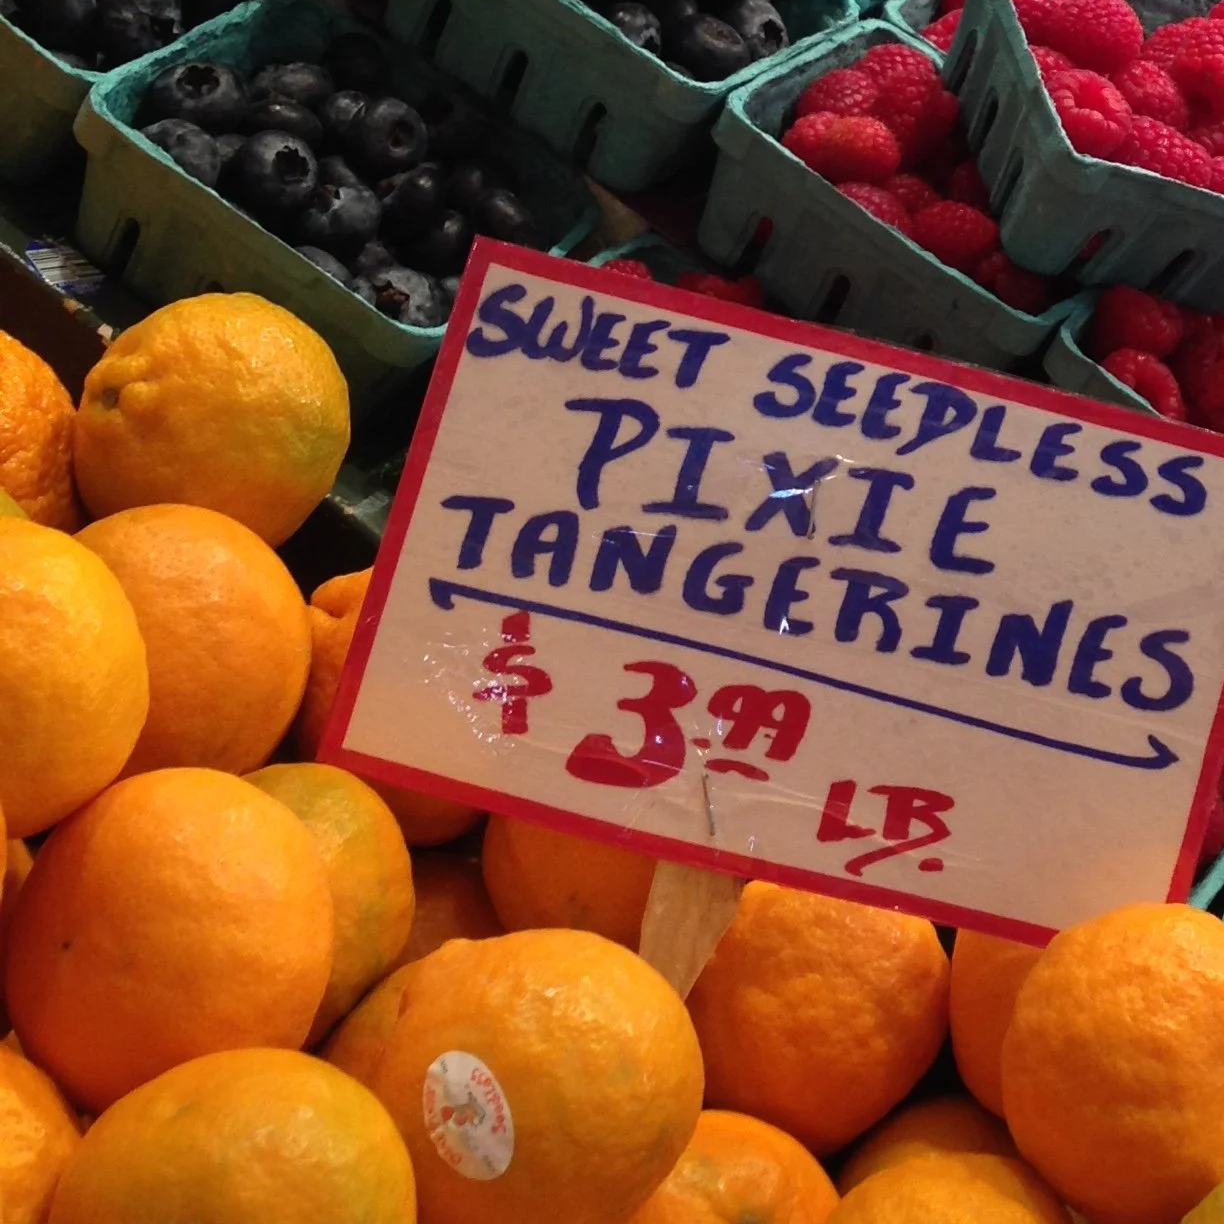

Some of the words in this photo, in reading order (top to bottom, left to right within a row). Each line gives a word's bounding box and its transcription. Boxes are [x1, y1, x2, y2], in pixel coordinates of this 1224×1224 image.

[466, 283, 730, 389] SWEET
[753, 353, 1208, 517] SEEDLESS
[566, 399, 996, 575] PIXIE
[442, 496, 1194, 712] TANGERINES
